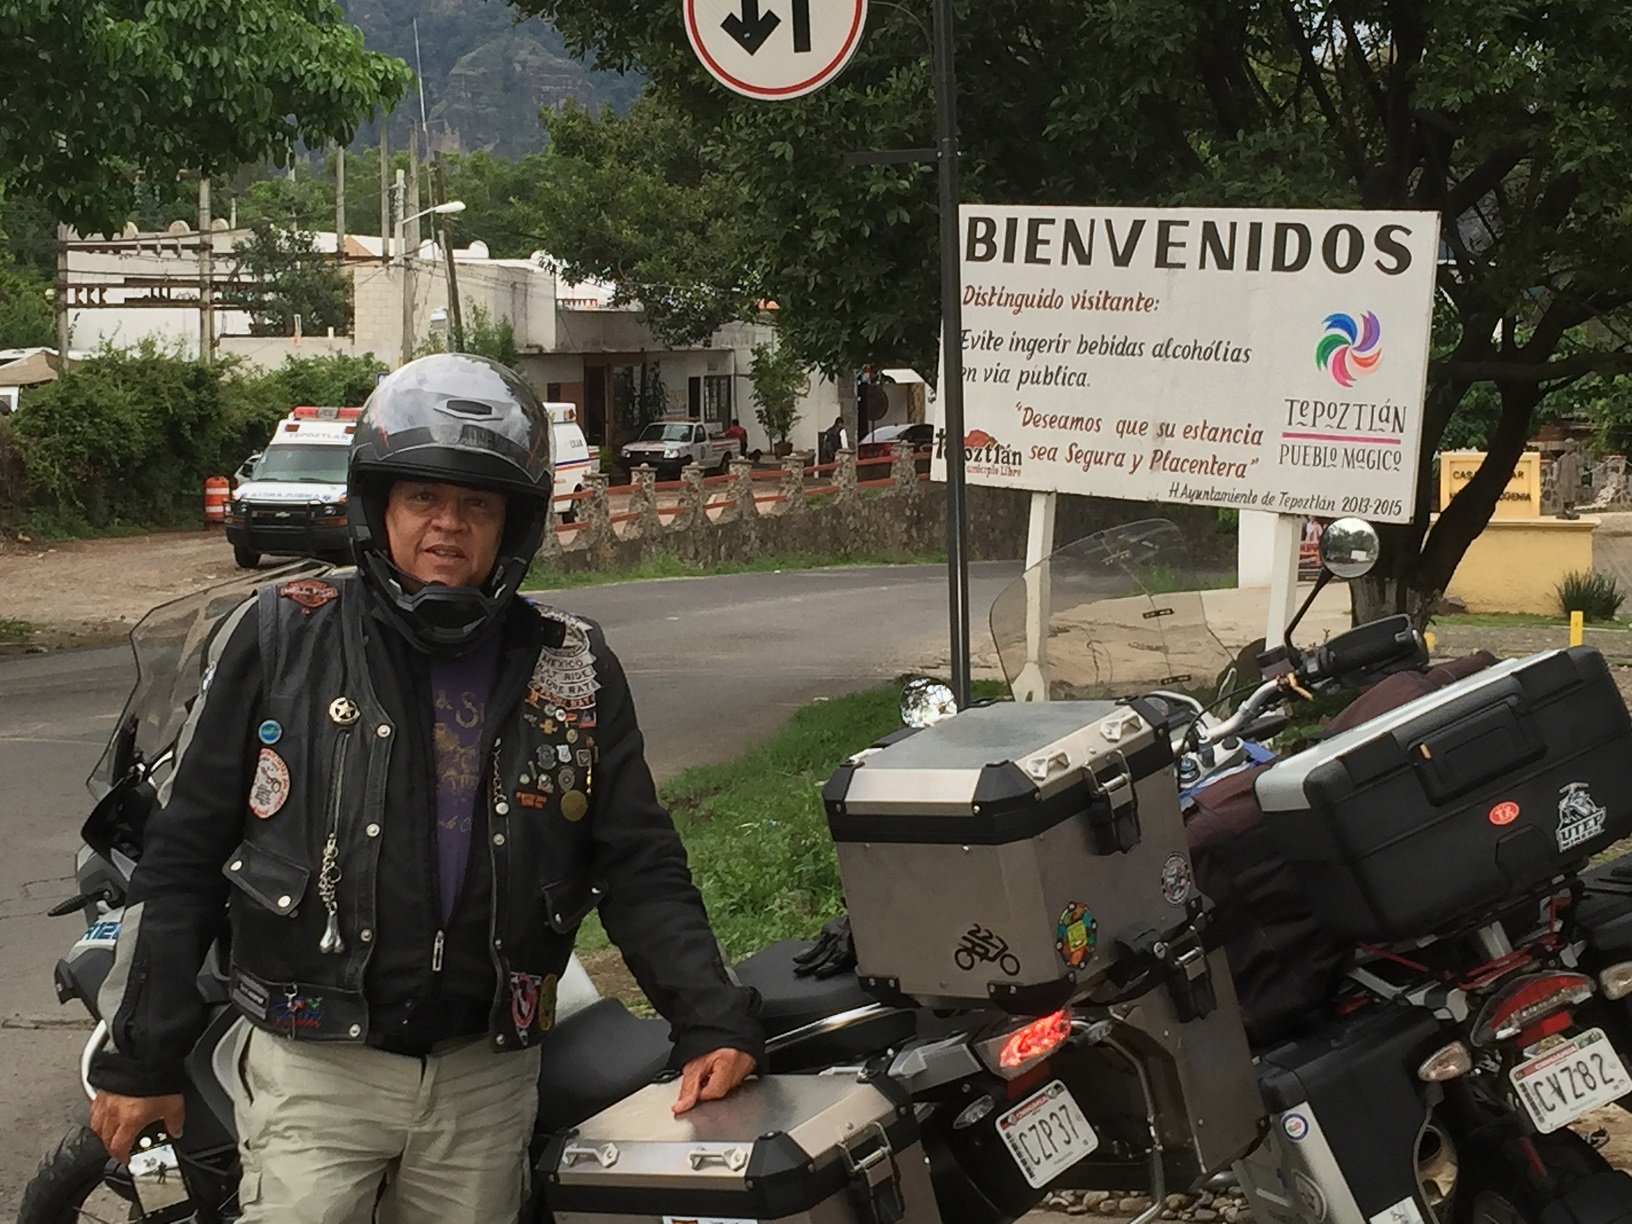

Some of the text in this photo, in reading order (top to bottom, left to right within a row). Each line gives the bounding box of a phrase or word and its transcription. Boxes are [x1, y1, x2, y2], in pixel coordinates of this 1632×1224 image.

[965, 216, 1413, 276] BIENVENIDOS
[962, 285, 1160, 316] Distinguido visitante:
[960, 329, 1004, 352] Evite
[1008, 332, 1072, 361] ingerir
[1077, 335, 1146, 358] bebidas
[936, 427, 1023, 466] toztlán
[1115, 418, 1149, 438] que
[1156, 421, 1177, 439] su
[1182, 419, 1264, 446] estancia
[1028, 444, 1058, 462] sea
[1064, 442, 1125, 473] Segura
[1128, 451, 1145, 475] y
[1279, 444, 1337, 468] PUEBLO
[1452, 470, 1477, 480] CAS
[1261, 490, 1276, 506] de
[1278, 492, 1336, 512] Tepoztlán
[1341, 497, 1402, 517] 2013-2015
[542, 655, 583, 668] MEXICO
[1562, 813, 1603, 842] UTEP
[1533, 1053, 1614, 1112] CVZ82
[1018, 1104, 1079, 1166] CZP37
